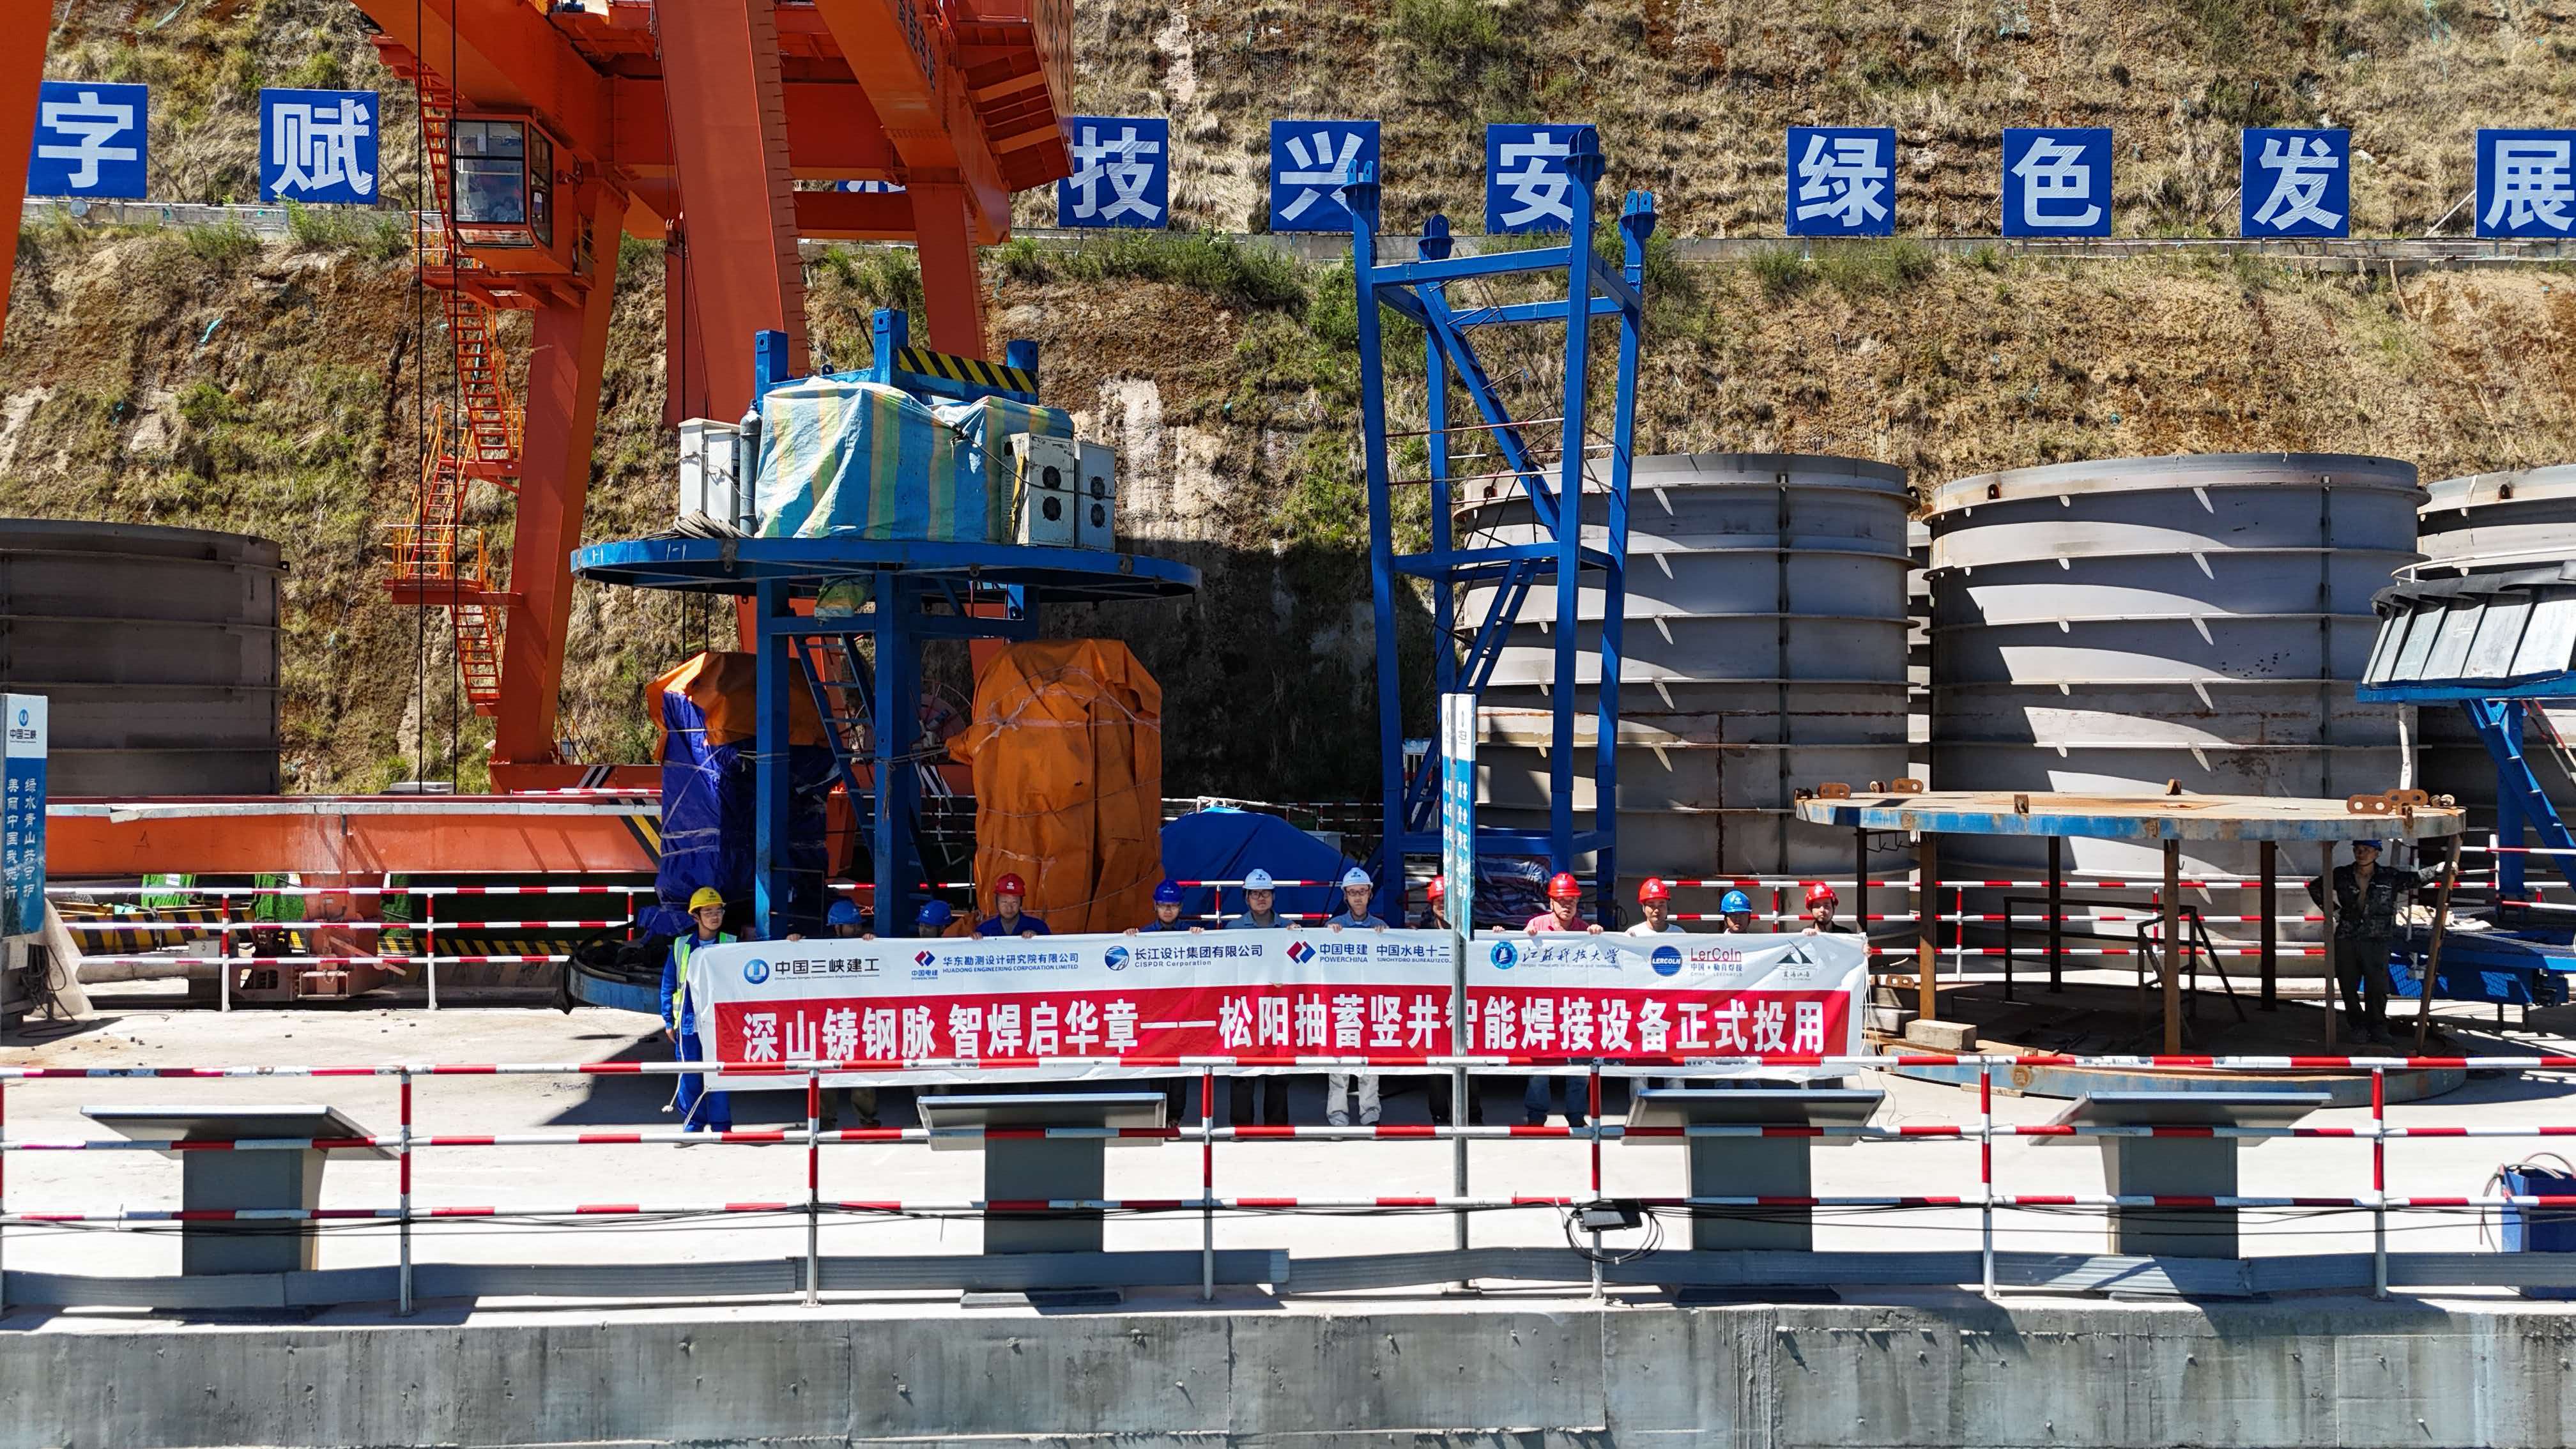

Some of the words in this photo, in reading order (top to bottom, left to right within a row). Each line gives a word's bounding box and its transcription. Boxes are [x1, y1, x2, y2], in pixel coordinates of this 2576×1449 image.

[38, 91, 136, 188] 字
[270, 99, 374, 195] 赋
[1069, 126, 1162, 221] 技
[1280, 130, 1365, 221] 兴
[1496, 132, 1572, 227] 安
[1796, 134, 1889, 227] 绿
[2011, 137, 2102, 227] 色
[2252, 137, 2343, 230] 发
[2483, 139, 2575, 230] 展
[10, 729, 36, 739] 中国三峡
[775, 958, 880, 975] 中国三峡建工
[943, 953, 1079, 966] 华东勘测设计研究院有限公司
[1135, 944, 1262, 960] 长江设计集团有限公司
[1320, 943, 1368, 955] 中国电建
[1377, 944, 1450, 957] 中国水电十二
[742, 1004, 937, 1062] 深山铸钢脉
